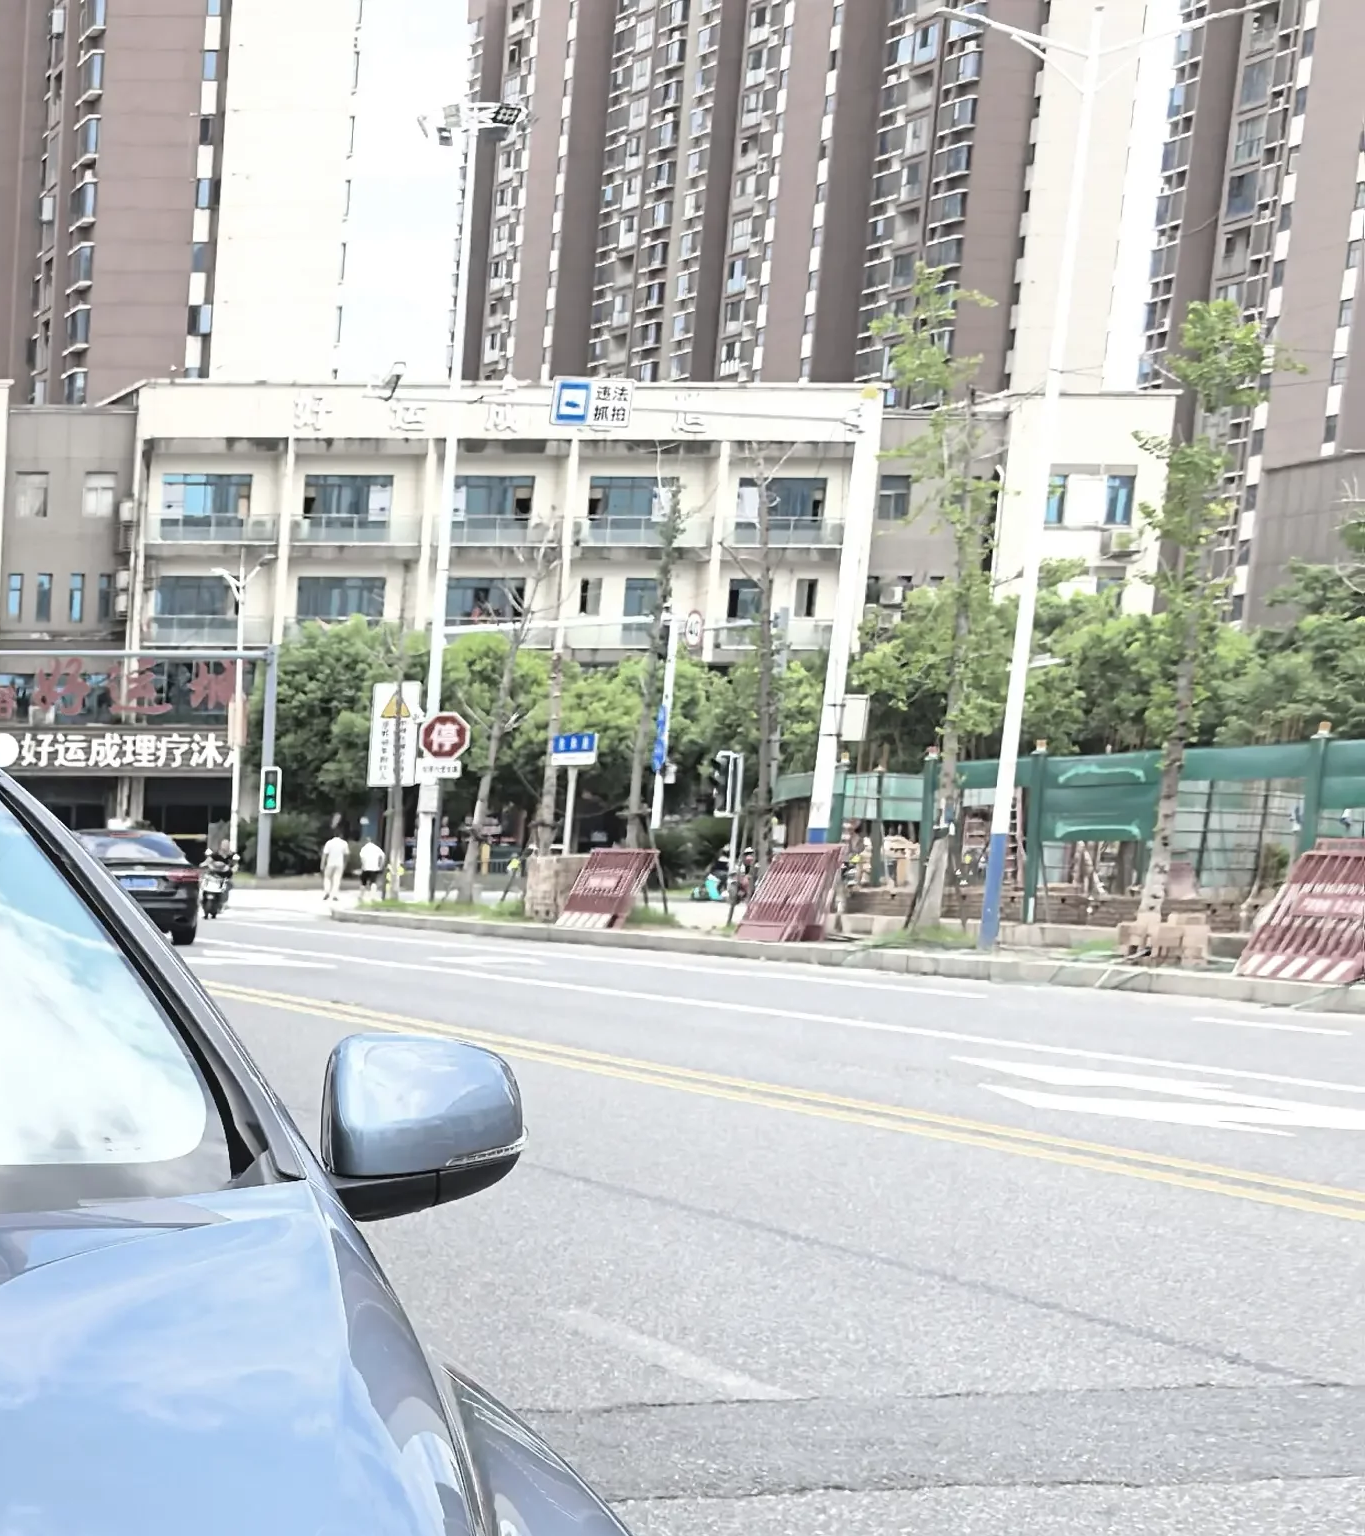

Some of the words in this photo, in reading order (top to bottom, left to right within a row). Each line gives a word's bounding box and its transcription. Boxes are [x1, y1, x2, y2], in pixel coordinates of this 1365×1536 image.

[596, 386, 629, 402] 违法
[593, 405, 626, 422] 抓拍
[430, 722, 460, 752] 停
